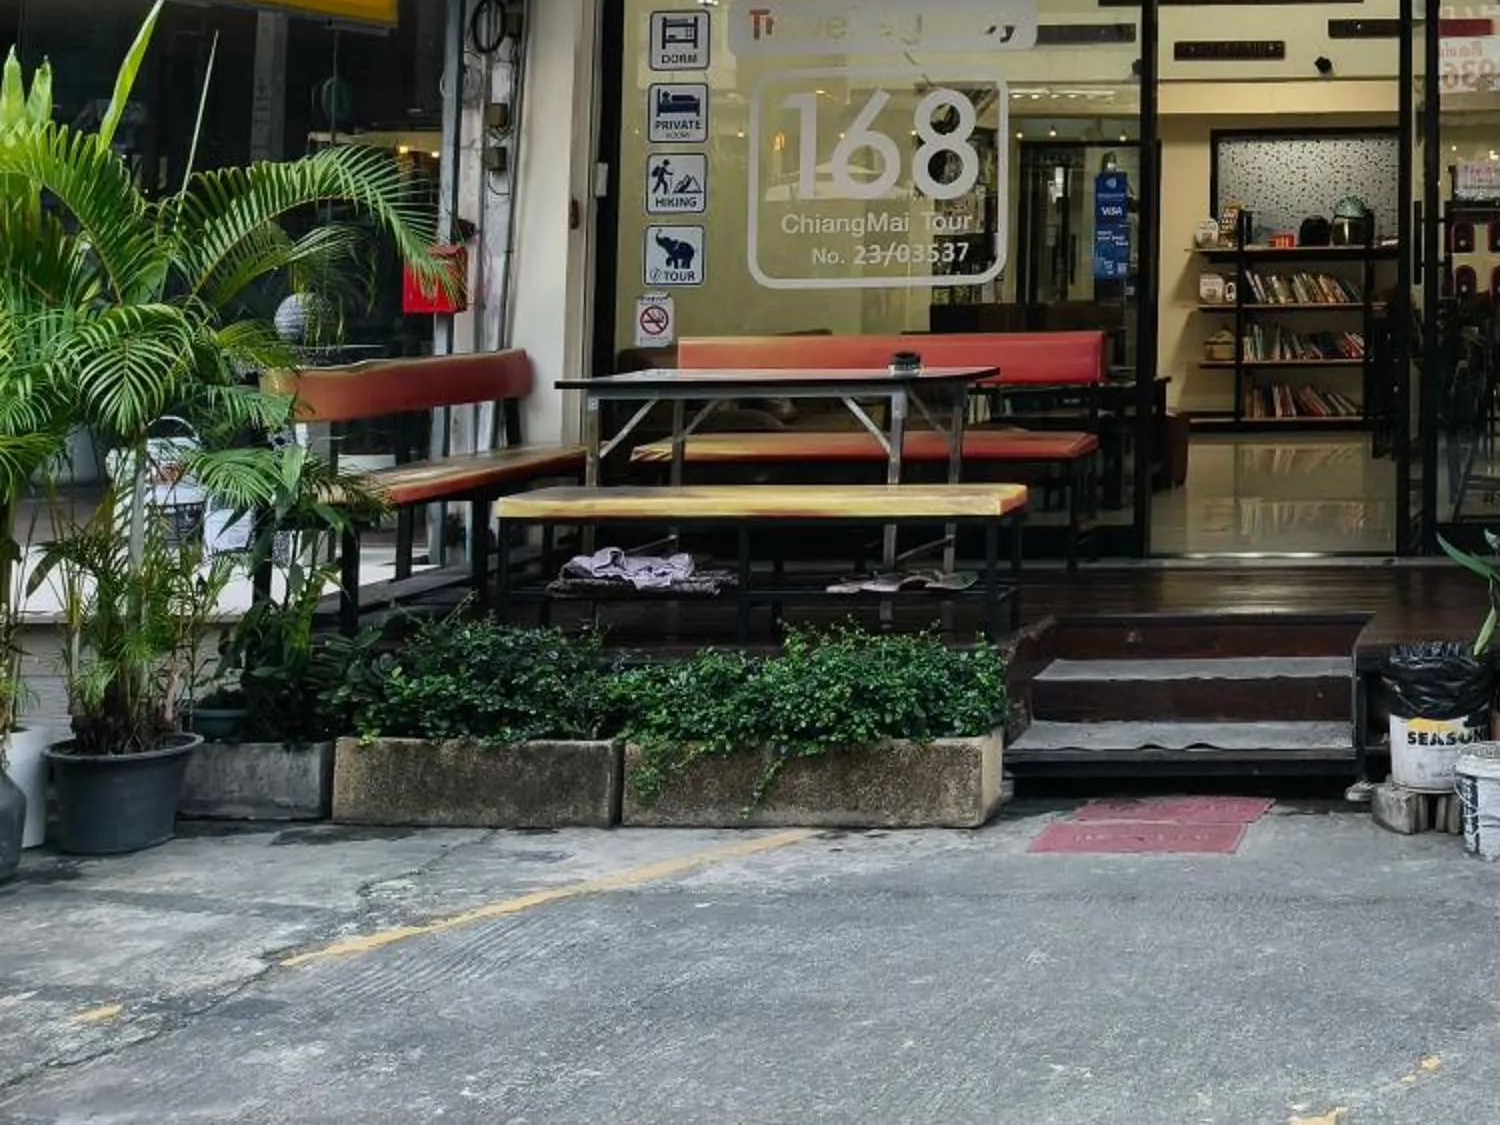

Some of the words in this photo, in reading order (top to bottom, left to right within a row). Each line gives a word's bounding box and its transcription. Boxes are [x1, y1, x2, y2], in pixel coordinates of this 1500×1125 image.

[655, 120, 702, 130] PRIVATE
[779, 86, 980, 200] 168
[656, 197, 697, 208] HIKING
[781, 213, 910, 236] ChiangMai
[921, 212, 973, 231] Tour
[664, 271, 695, 282] TOUR
